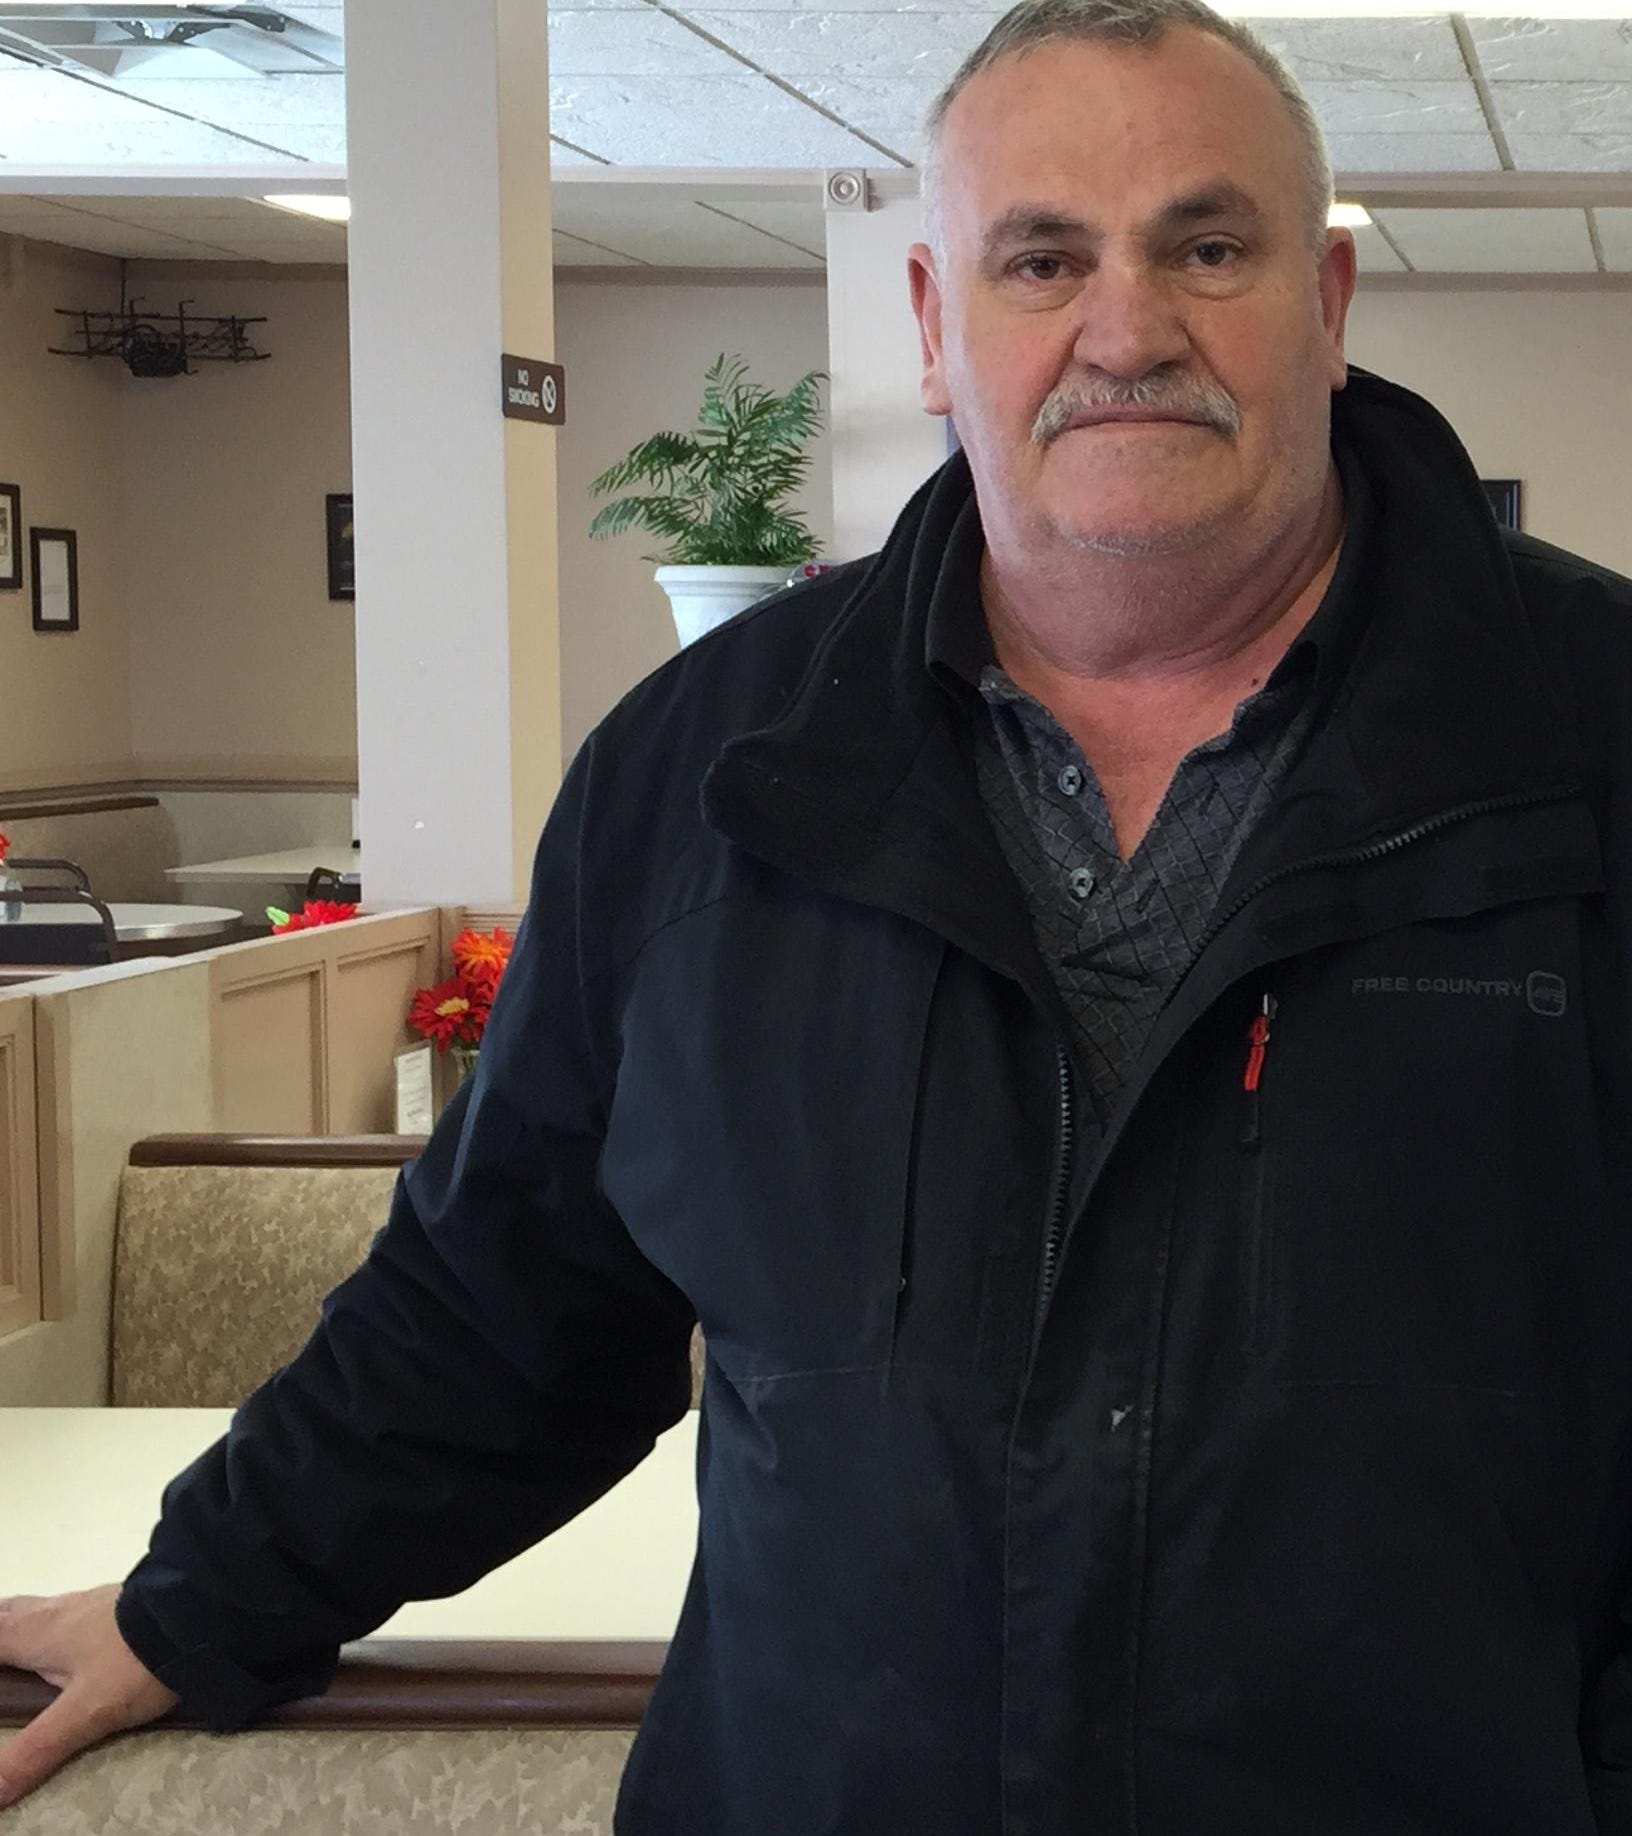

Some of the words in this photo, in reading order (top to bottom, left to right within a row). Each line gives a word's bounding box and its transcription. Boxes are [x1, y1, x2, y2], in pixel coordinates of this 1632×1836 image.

[518, 369, 529, 386] NO
[508, 387, 540, 408] SMOKING
[1351, 977, 1410, 995] FREE
[1416, 977, 1523, 997] COUNTRY
